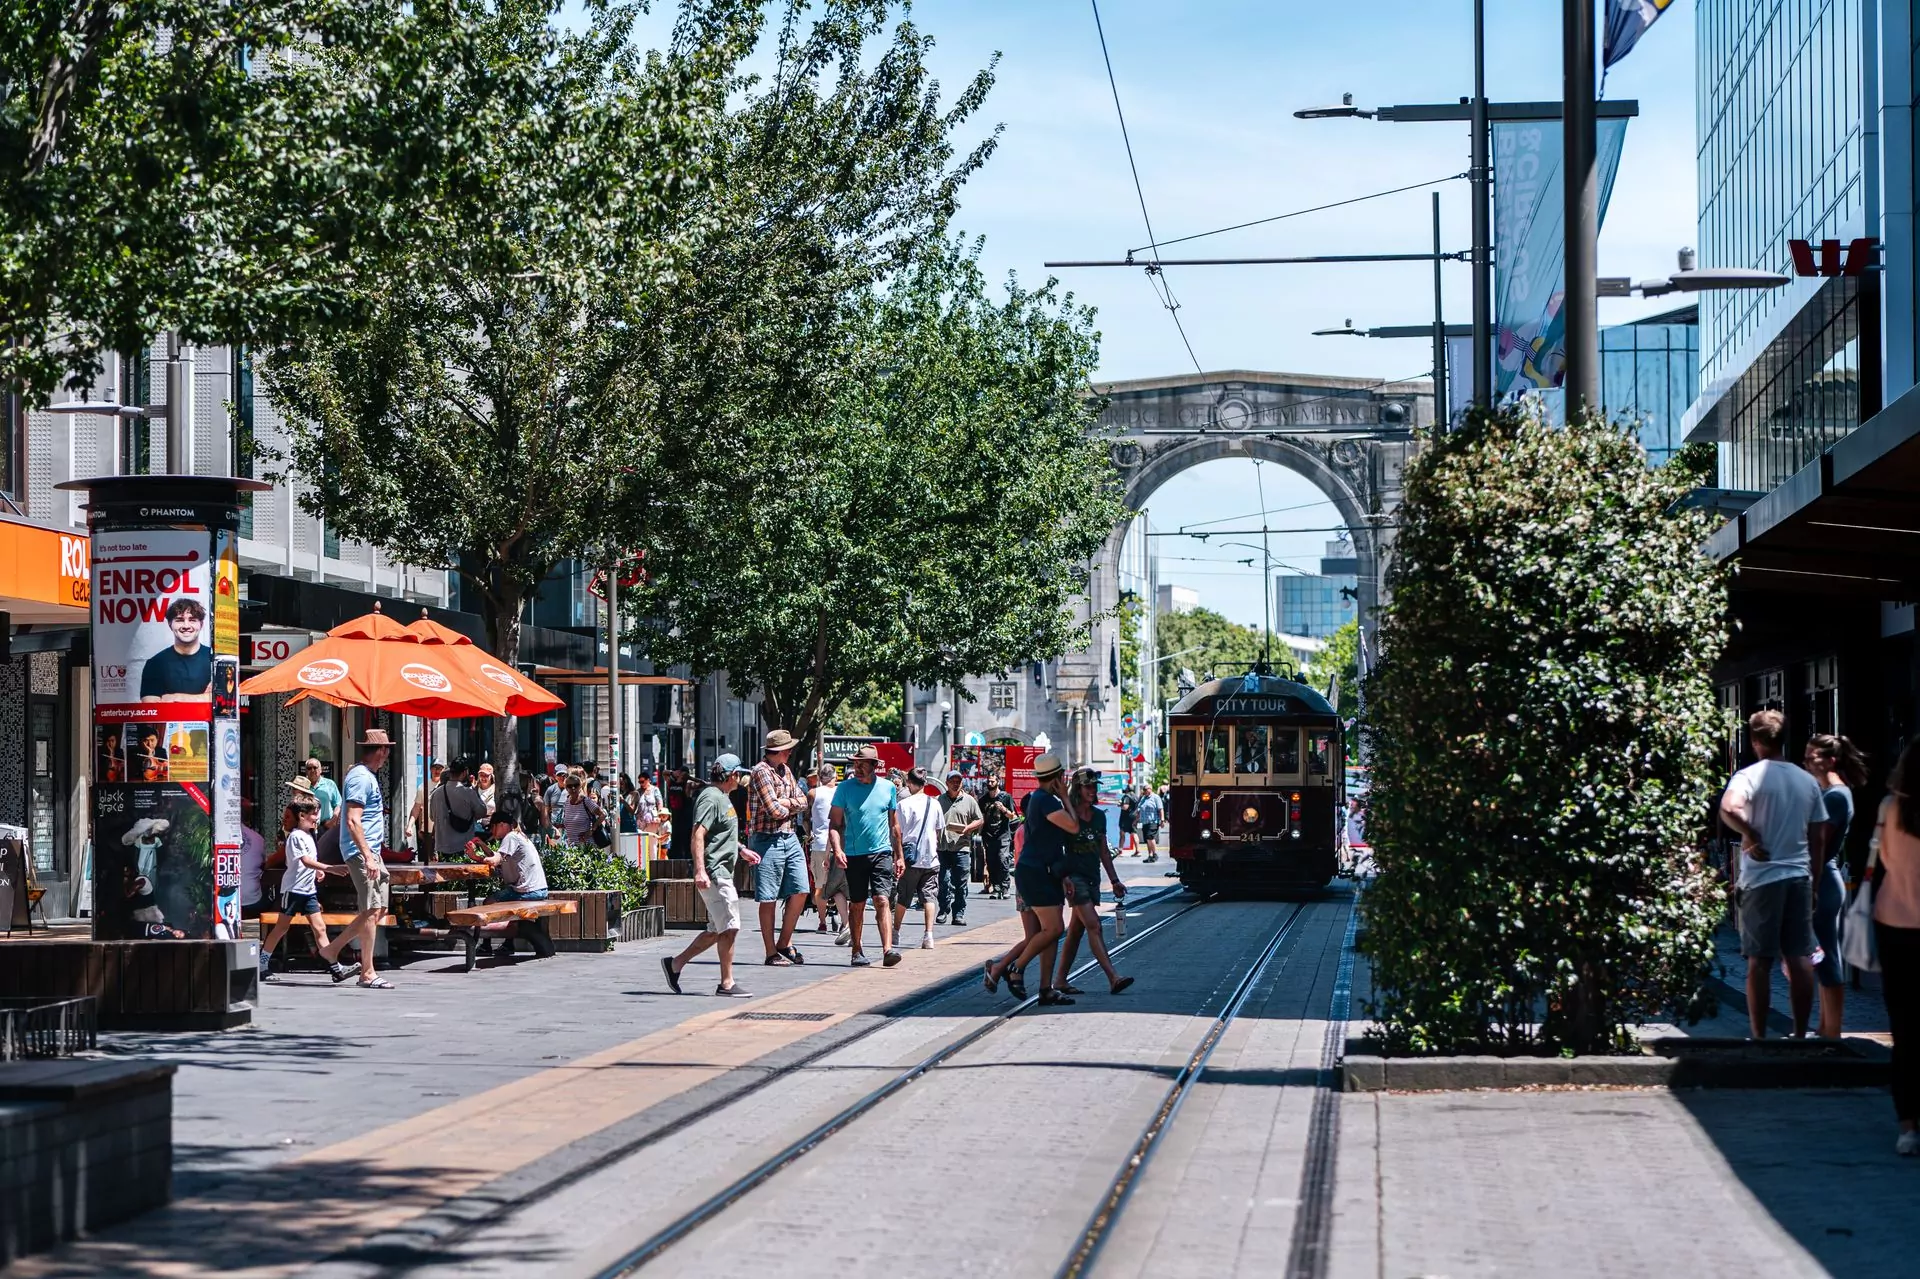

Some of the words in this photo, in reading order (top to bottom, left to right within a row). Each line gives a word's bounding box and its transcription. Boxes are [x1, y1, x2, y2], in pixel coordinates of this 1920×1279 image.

[151, 508, 195, 517] PHANTOM
[107, 544, 118, 552] not
[132, 543, 148, 551] late
[99, 567, 200, 596] ENROL
[99, 597, 171, 625] NOW
[1216, 699, 1247, 711] CITY
[1252, 699, 1286, 711] TOUR
[101, 708, 158, 717] canterbury.ac.nz
[824, 741, 869, 753] RIVERS
[1240, 833, 1262, 843] 244
